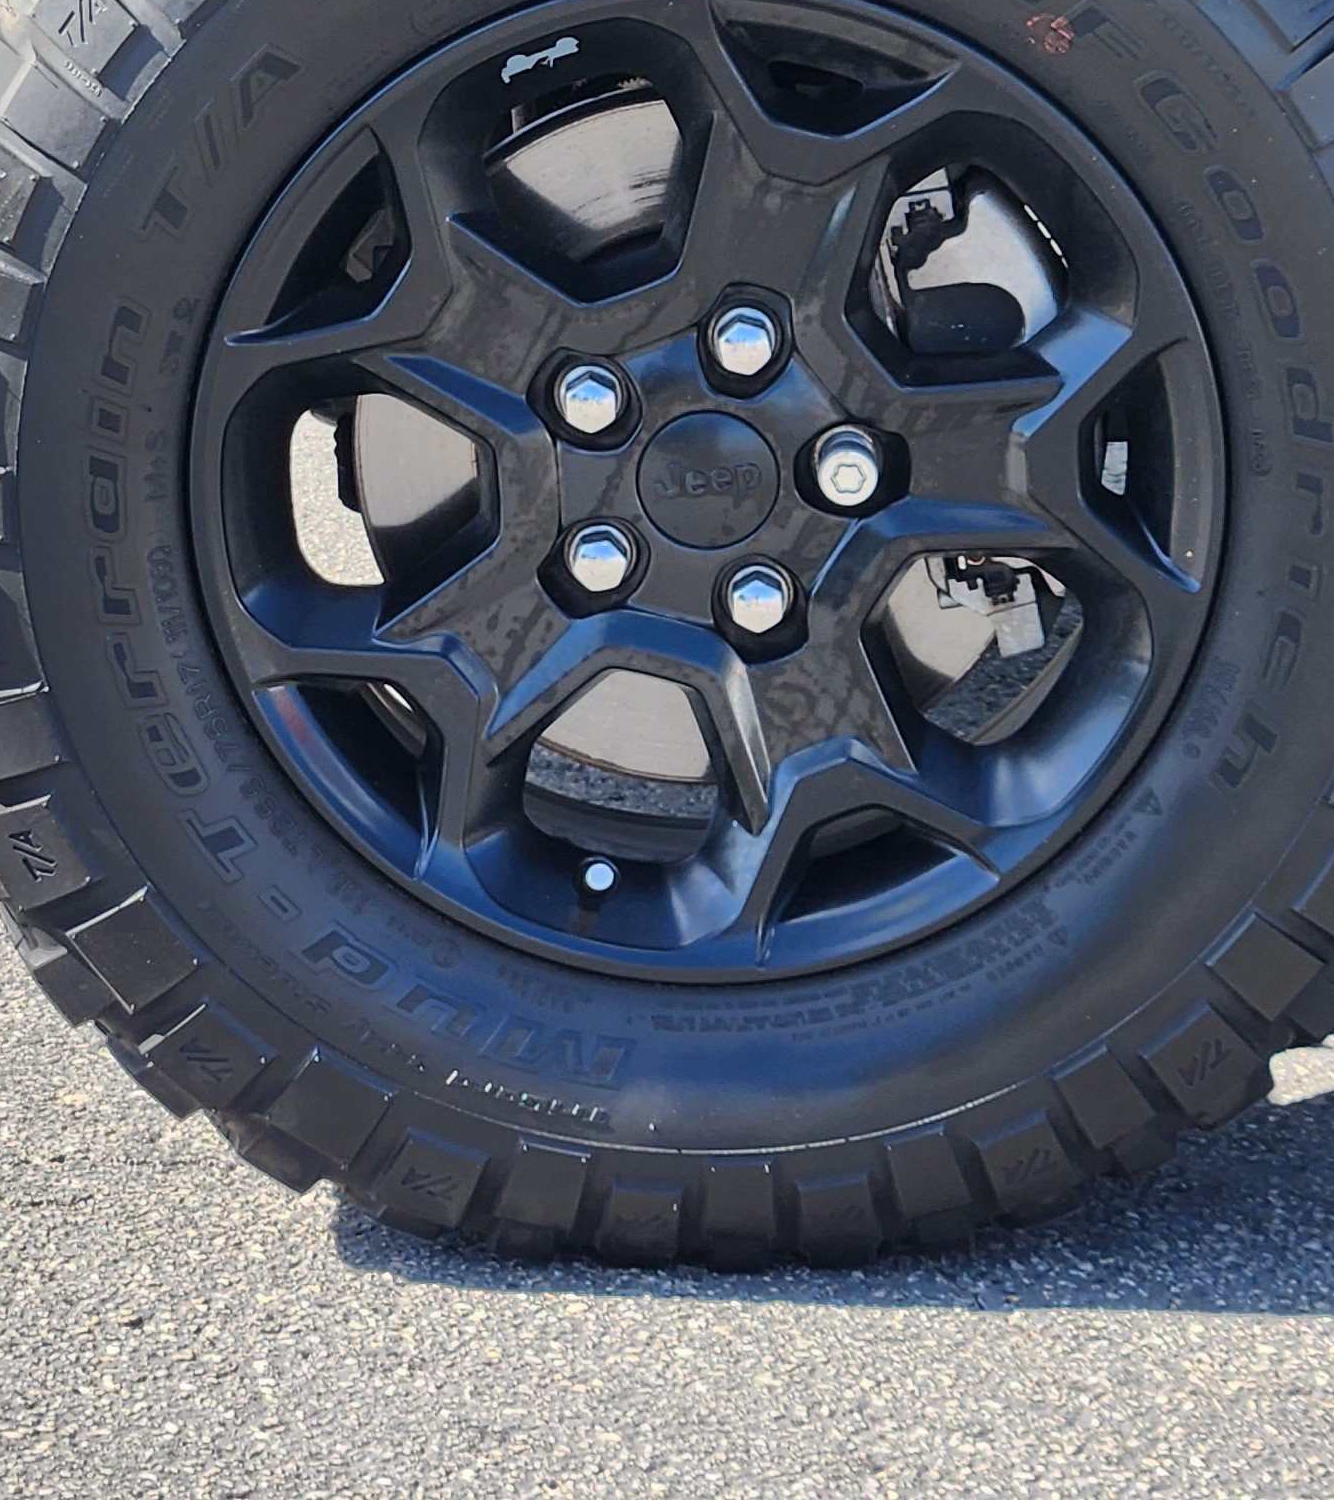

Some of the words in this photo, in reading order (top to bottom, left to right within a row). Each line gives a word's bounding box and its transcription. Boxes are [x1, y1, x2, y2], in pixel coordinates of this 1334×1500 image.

[137, 43, 309, 246] T/A
[652, 461, 763, 510] Jeep
[83, 295, 639, 1094] Mud-Terrain
[8, 827, 59, 884] T/A
